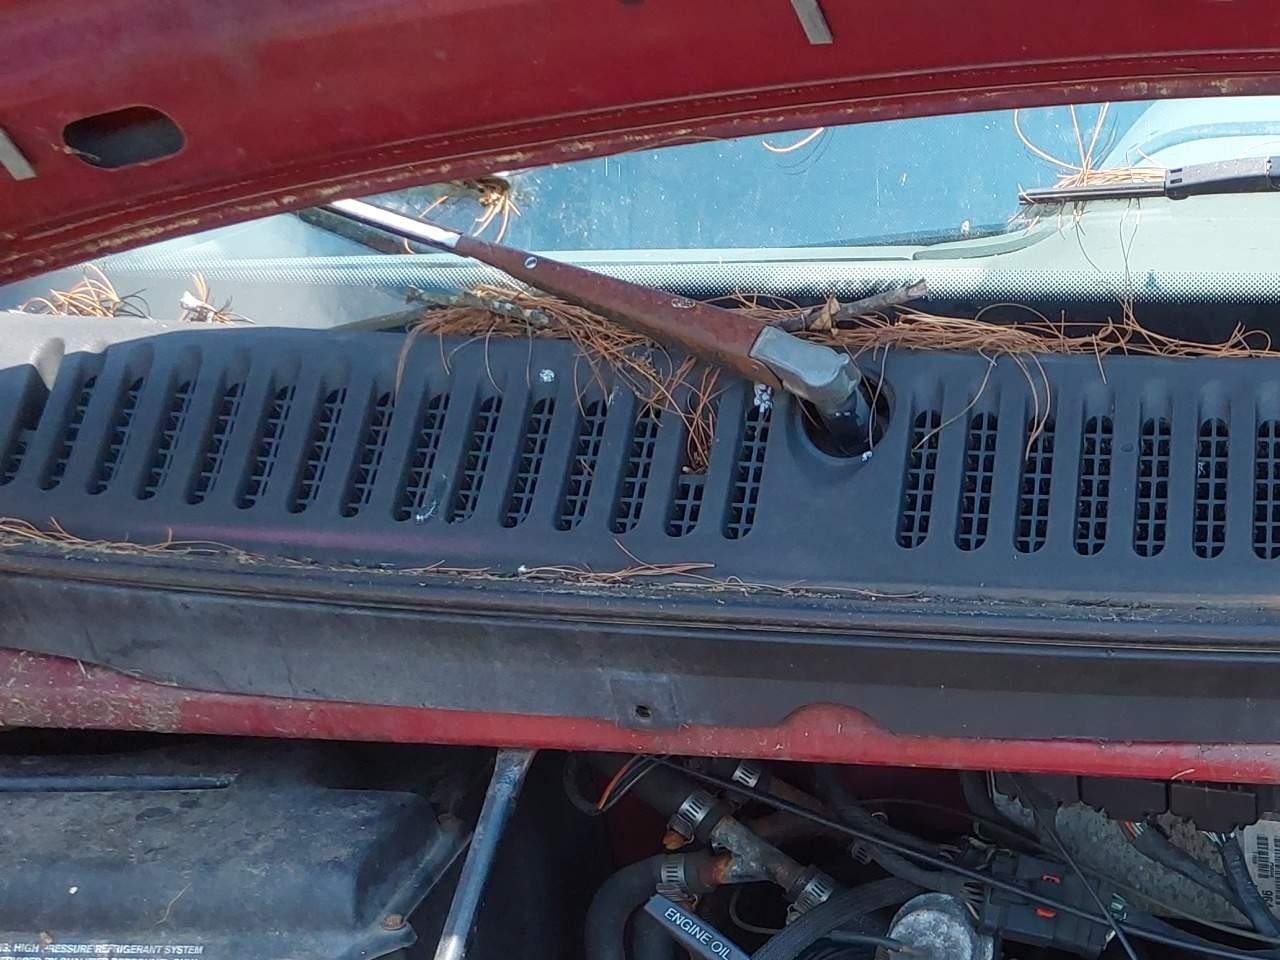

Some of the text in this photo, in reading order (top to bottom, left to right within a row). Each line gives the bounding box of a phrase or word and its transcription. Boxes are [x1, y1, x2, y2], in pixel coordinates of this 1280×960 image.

[14, 943, 40, 953] HIGH
[94, 944, 163, 954] REFRIGERANT
[163, 945, 204, 955] SYSTEM
[664, 907, 731, 960] ENGINE OIL
